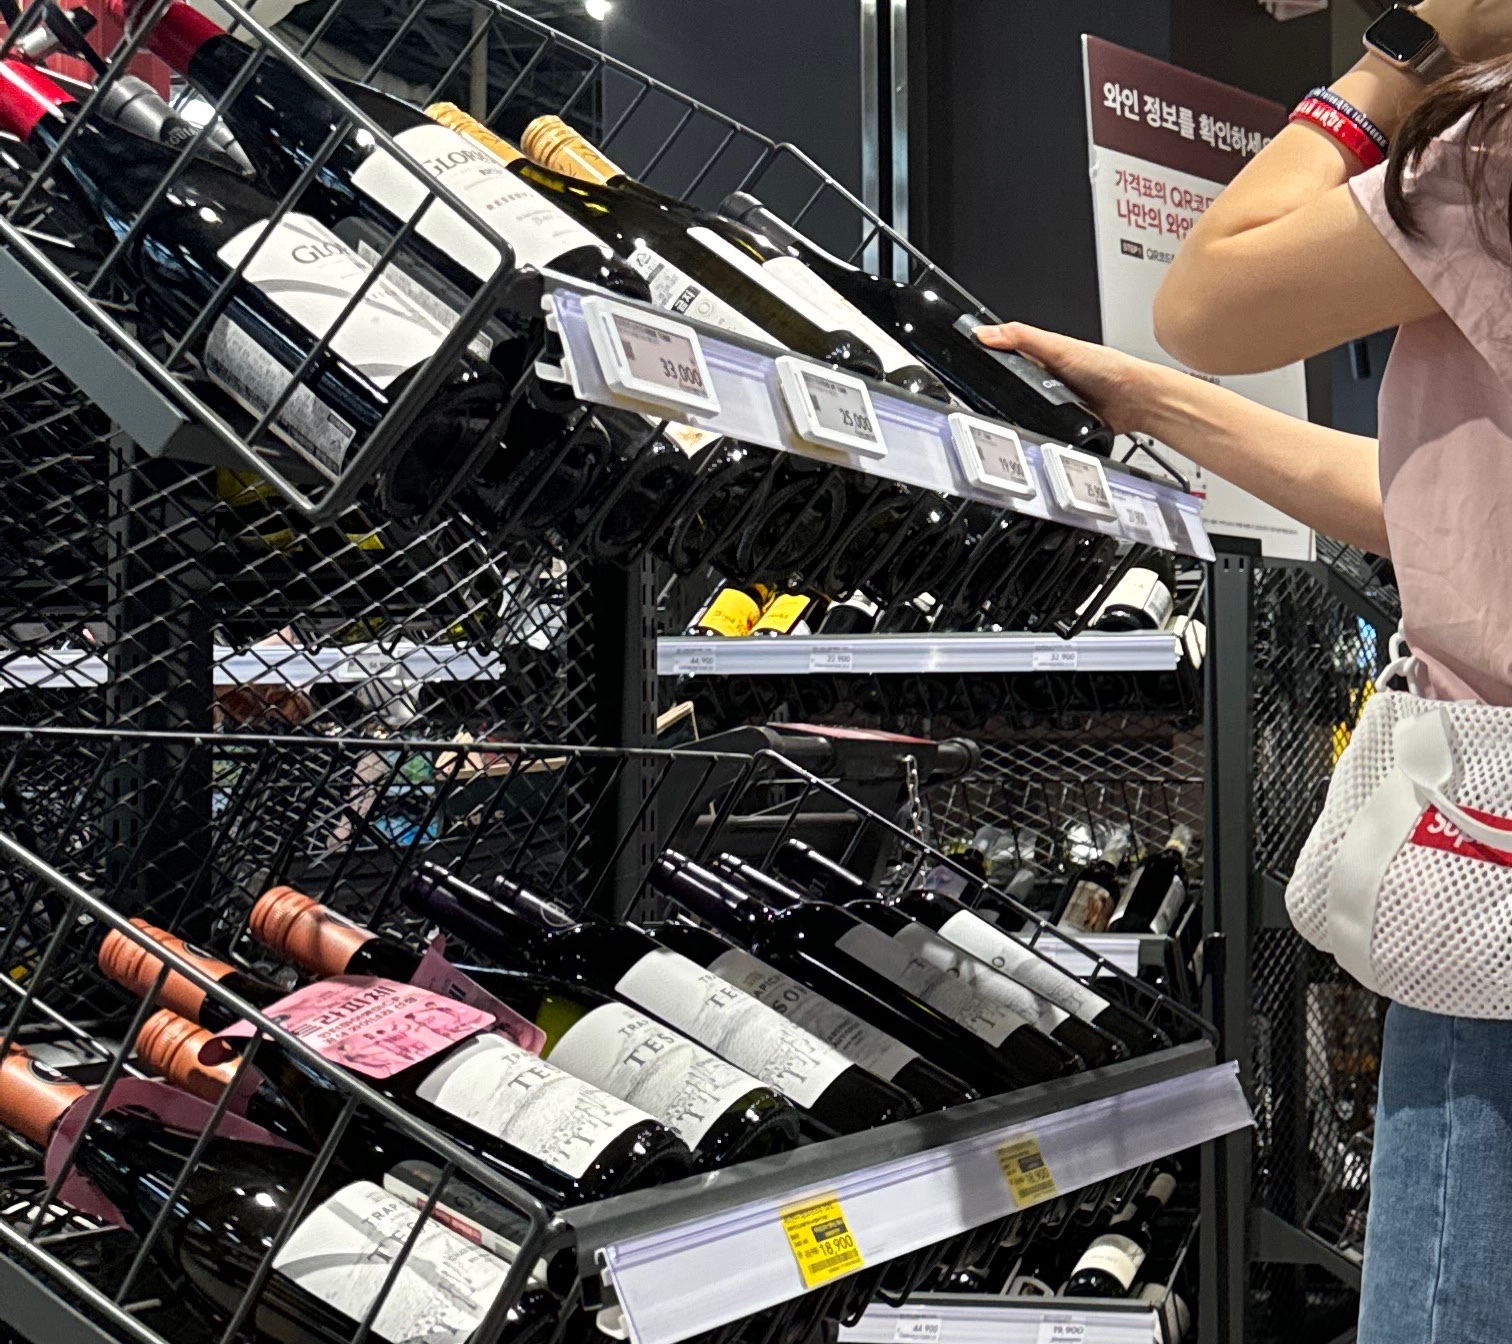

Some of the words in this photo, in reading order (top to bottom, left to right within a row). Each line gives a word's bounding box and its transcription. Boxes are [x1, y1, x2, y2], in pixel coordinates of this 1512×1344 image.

[1103, 82, 1140, 122] 와인
[1142, 94, 1196, 141] 정보를
[1114, 169, 1168, 204] 가격표의
[1117, 198, 1163, 235] 나만의
[660, 357, 703, 388] 33,000
[819, 1234, 854, 1257] 18,900
